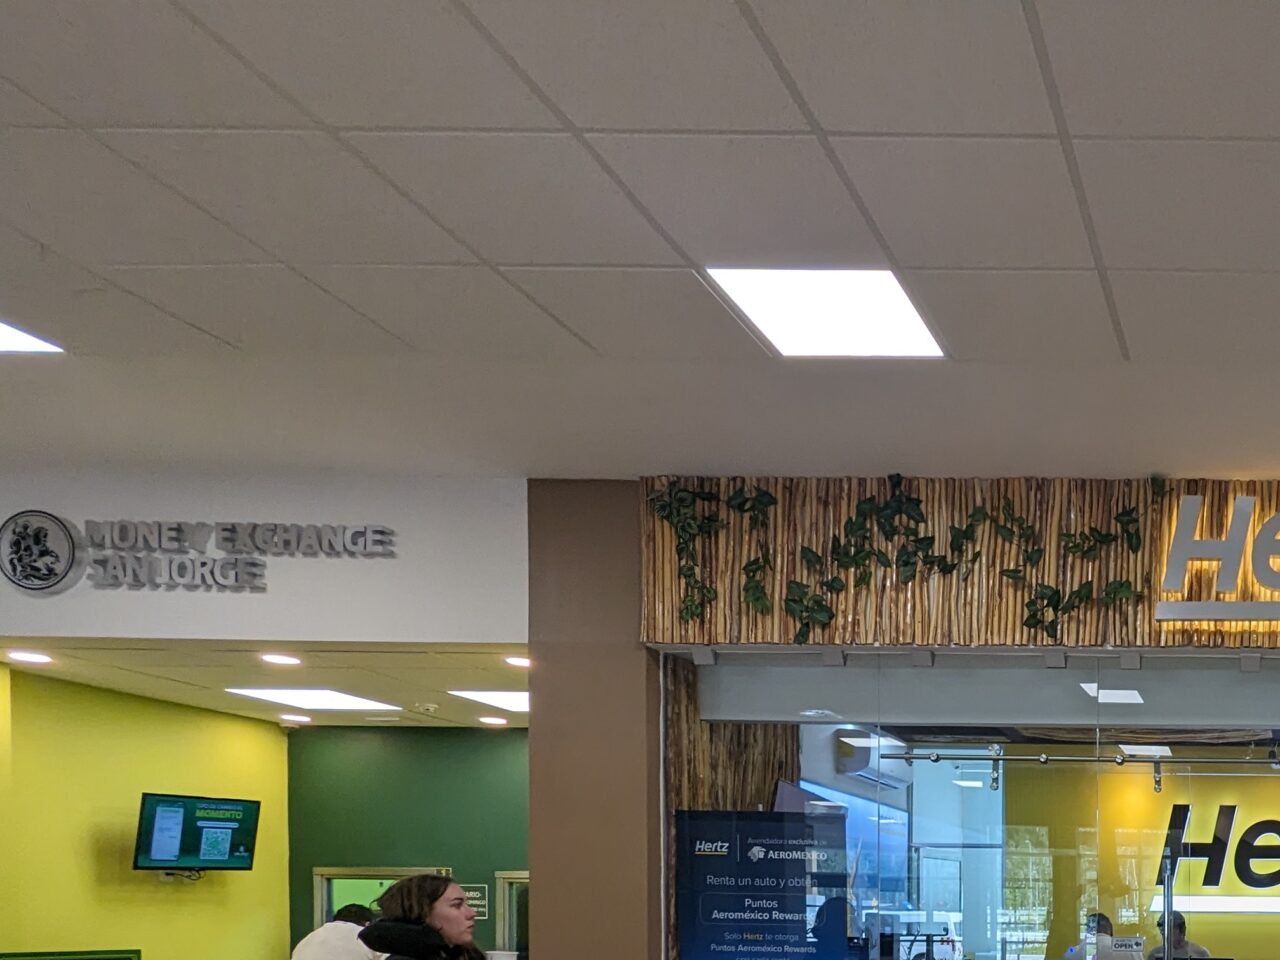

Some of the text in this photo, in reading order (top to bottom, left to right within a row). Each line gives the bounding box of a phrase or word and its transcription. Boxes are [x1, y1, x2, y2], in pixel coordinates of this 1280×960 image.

[86, 520, 396, 557] MONEY EXCHANGE
[88, 553, 267, 591] SAN JORGE
[195, 809, 243, 819] MOMENTO
[695, 840, 729, 852] Hertz
[706, 875, 735, 886] Renta
[738, 878, 751, 886] un
[754, 877, 776, 886] auto
[779, 879, 785, 888] y
[745, 898, 778, 908] Puntos
[712, 910, 769, 920] Aeroméxico
[724, 932, 742, 940] Solo
[743, 932, 763, 940] Hertz
[775, 934, 799, 943] otorga
[710, 944, 816, 954] Puntos Aeroméxico Rewards
